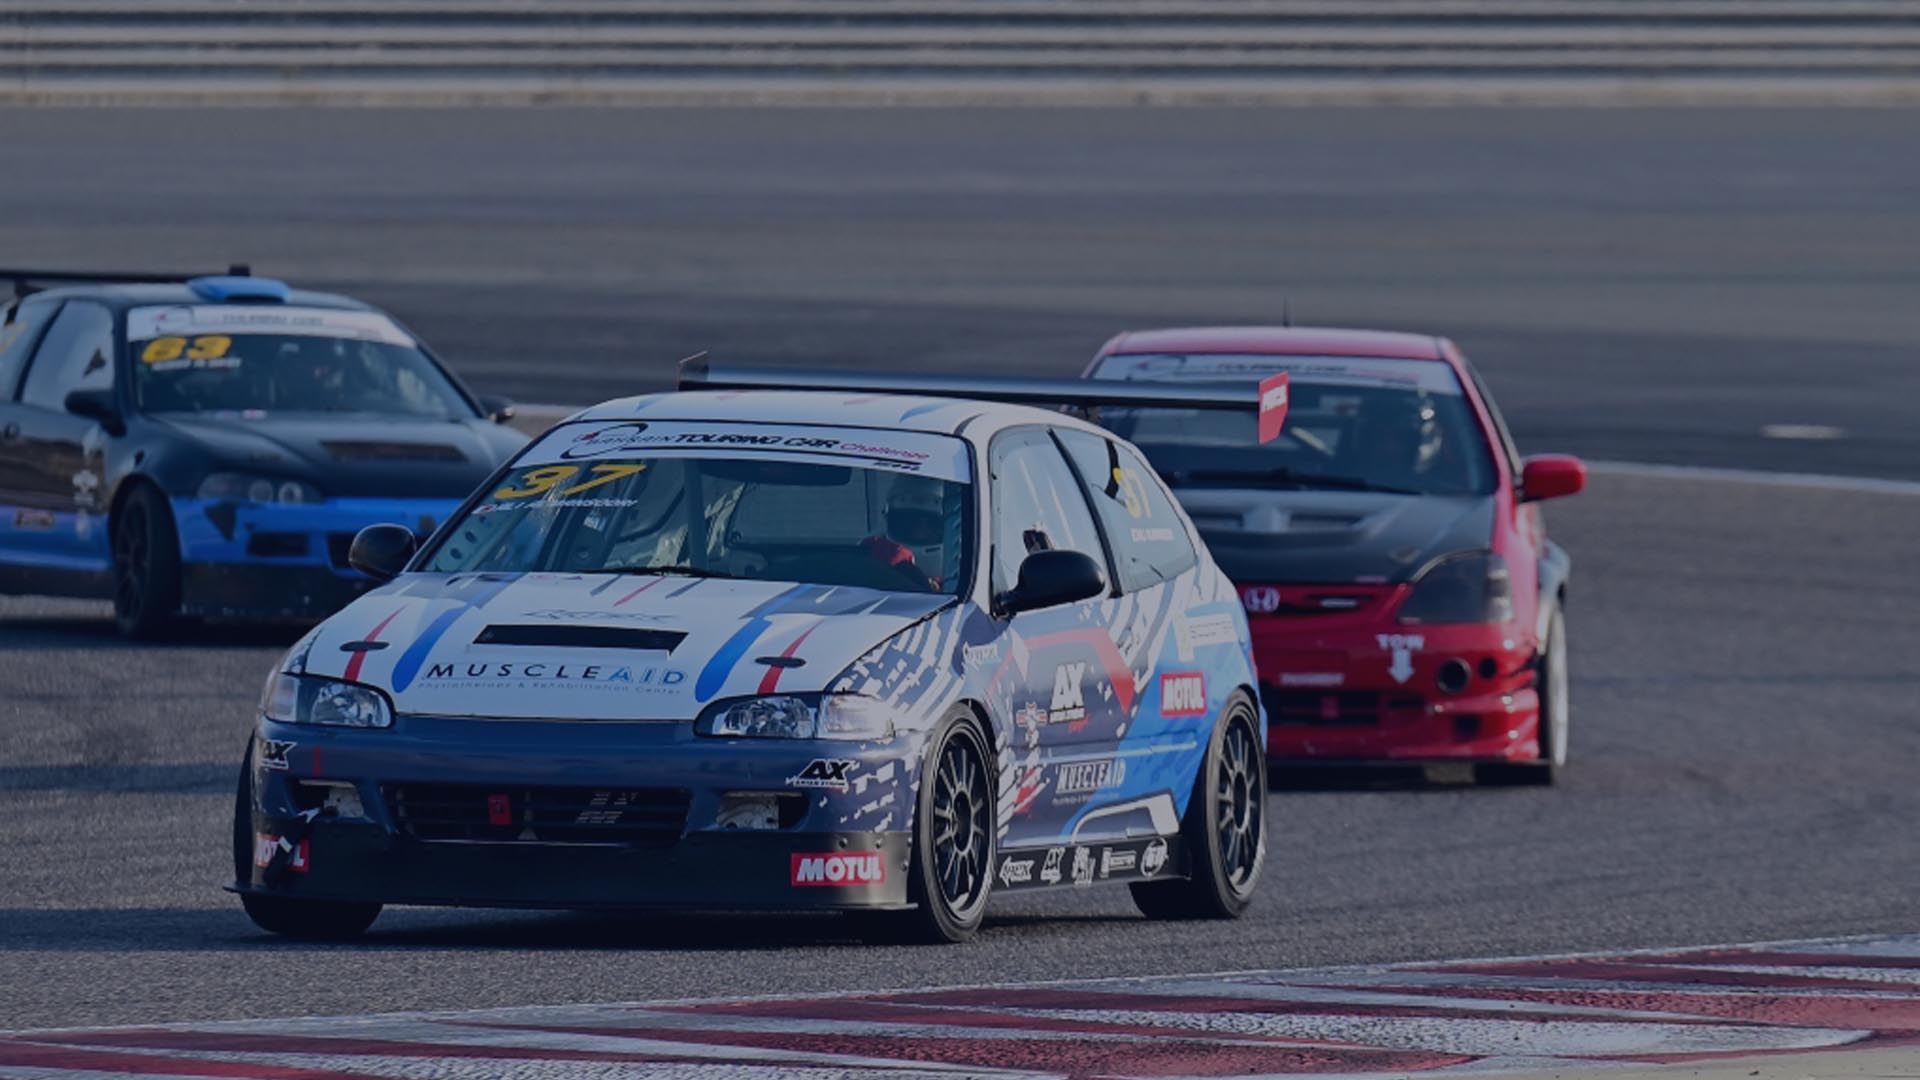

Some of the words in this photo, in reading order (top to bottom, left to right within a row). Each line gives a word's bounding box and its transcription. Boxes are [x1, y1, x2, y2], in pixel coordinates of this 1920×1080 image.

[675, 433, 783, 445] TOURING
[784, 437, 840, 448] CAR
[494, 464, 647, 499] 37
[1375, 633, 1425, 650] TOW
[426, 663, 686, 684] MUSCLEAID
[1050, 662, 1086, 710] AX
[1162, 677, 1204, 711] MOTUL
[799, 758, 856, 781] AX
[796, 857, 882, 882] MOTUL
